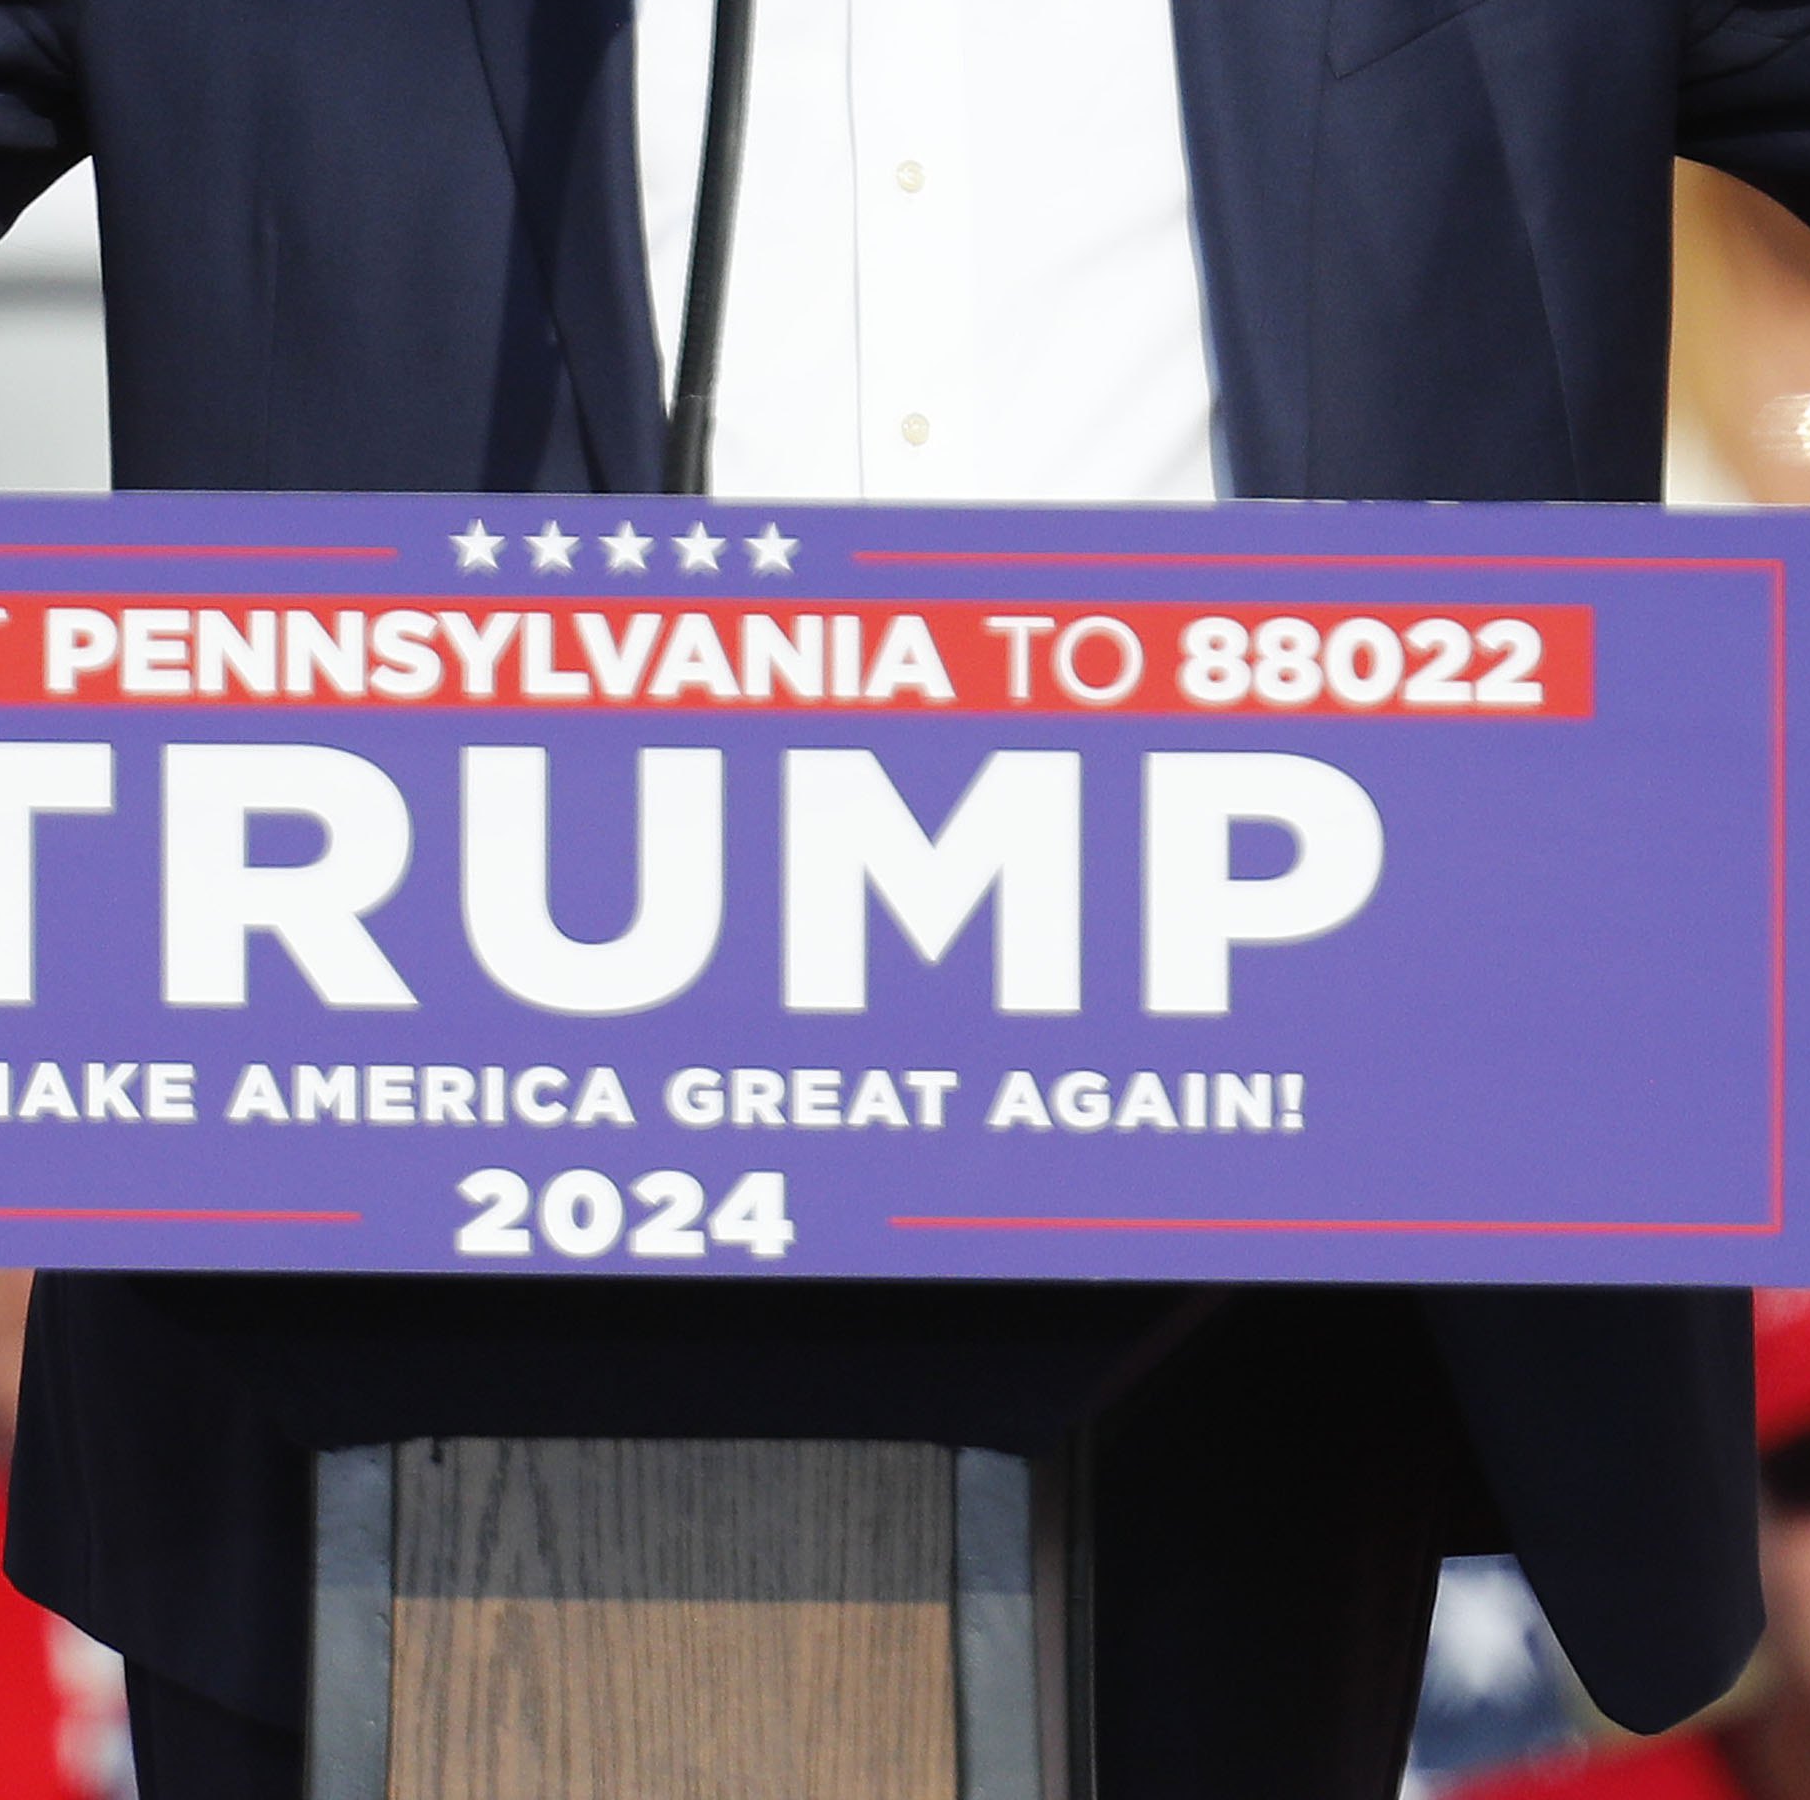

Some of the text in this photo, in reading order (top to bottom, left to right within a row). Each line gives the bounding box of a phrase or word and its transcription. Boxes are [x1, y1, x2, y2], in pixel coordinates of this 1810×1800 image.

[45, 607, 957, 702] PENNSYLVANIA
[985, 615, 1145, 705] TO
[1179, 615, 1544, 707] 88022
[225, 1063, 638, 1129] AMERICA
[664, 1066, 959, 1129] GREAT
[986, 1069, 1305, 1132] AGAIN!
[454, 1167, 796, 1260] 2024
